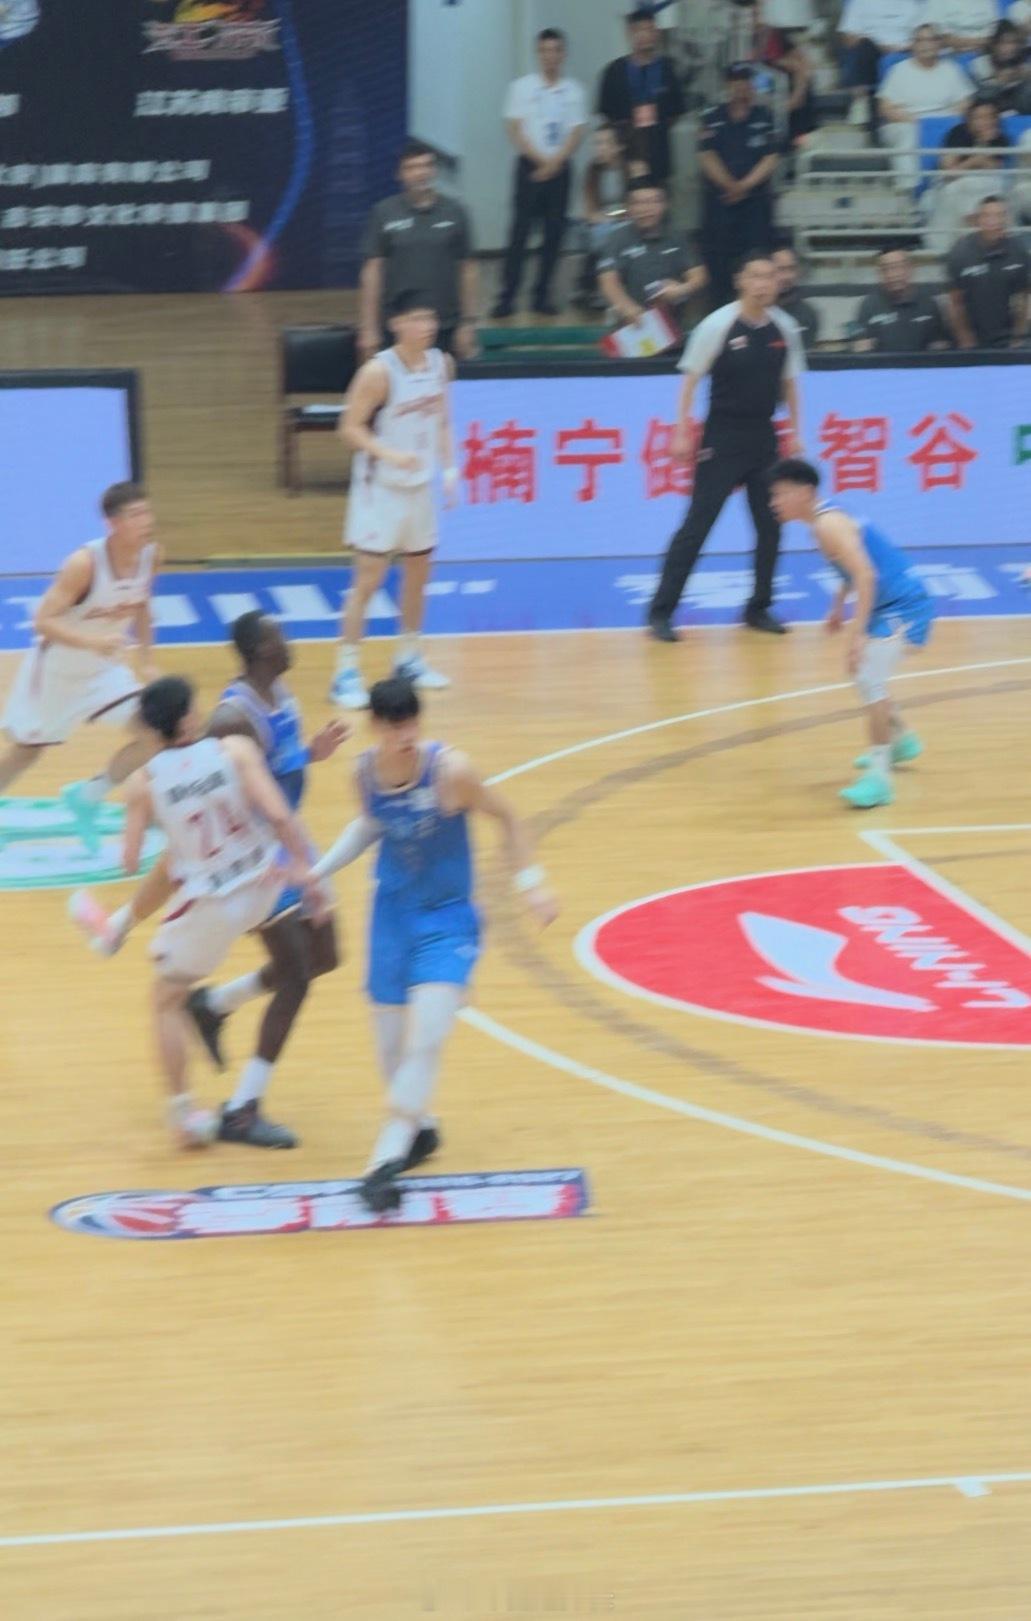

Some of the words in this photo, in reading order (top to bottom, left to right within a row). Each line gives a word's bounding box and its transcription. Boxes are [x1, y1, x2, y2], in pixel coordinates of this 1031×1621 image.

[463, 412, 978, 503] 楠宁健智谷
